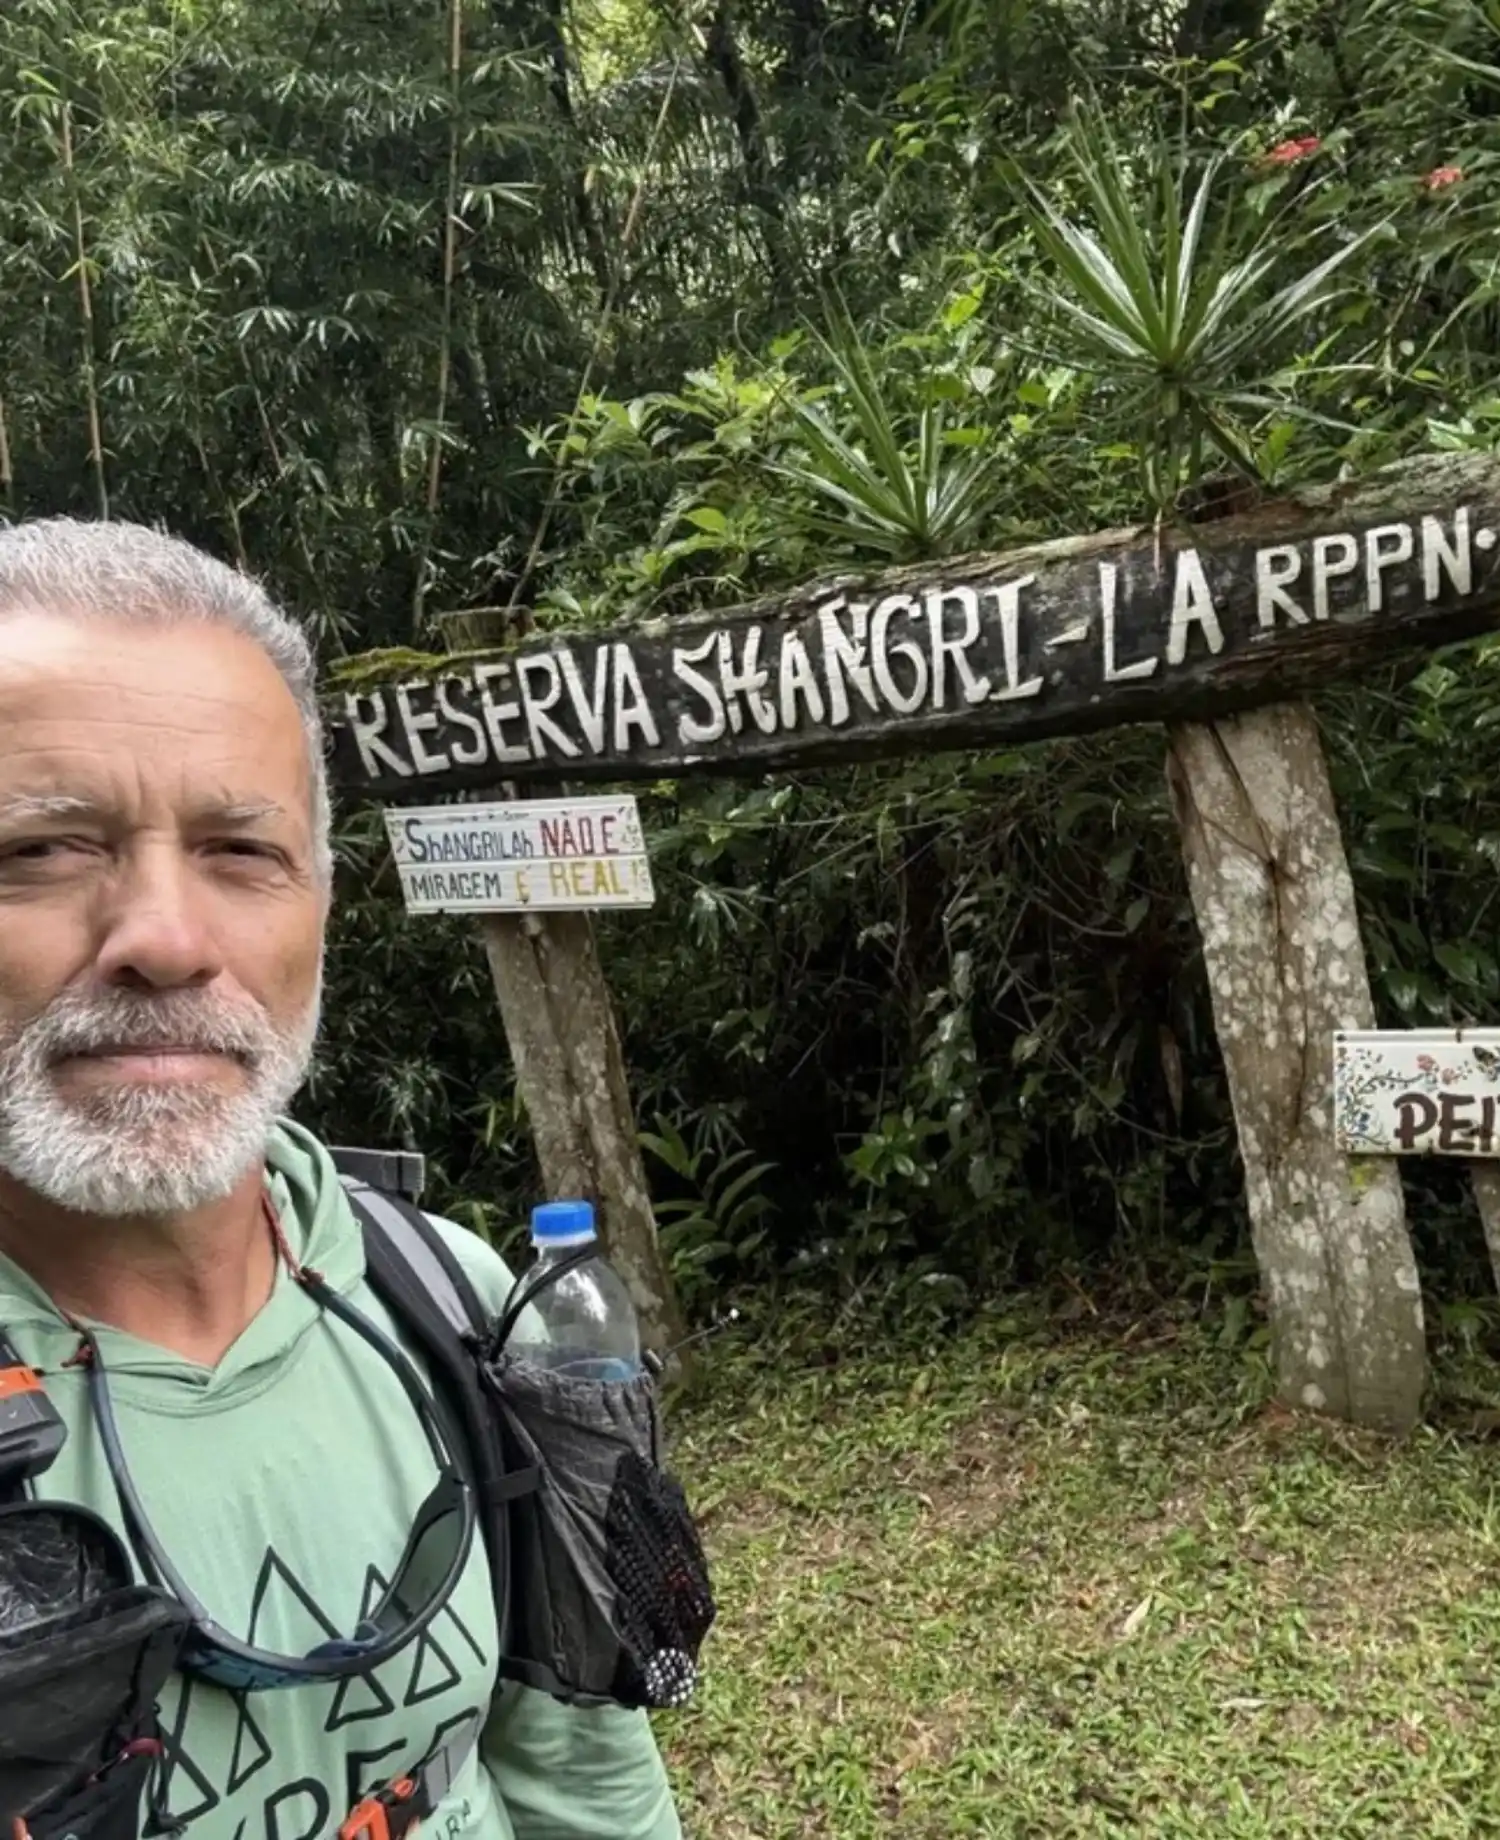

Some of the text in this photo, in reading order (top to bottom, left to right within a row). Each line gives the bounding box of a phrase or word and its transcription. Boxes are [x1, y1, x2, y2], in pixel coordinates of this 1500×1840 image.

[346, 643, 660, 779] RESERVA
[410, 872, 502, 900] MIRAGEM
[1393, 1092, 1500, 1152] PEI
